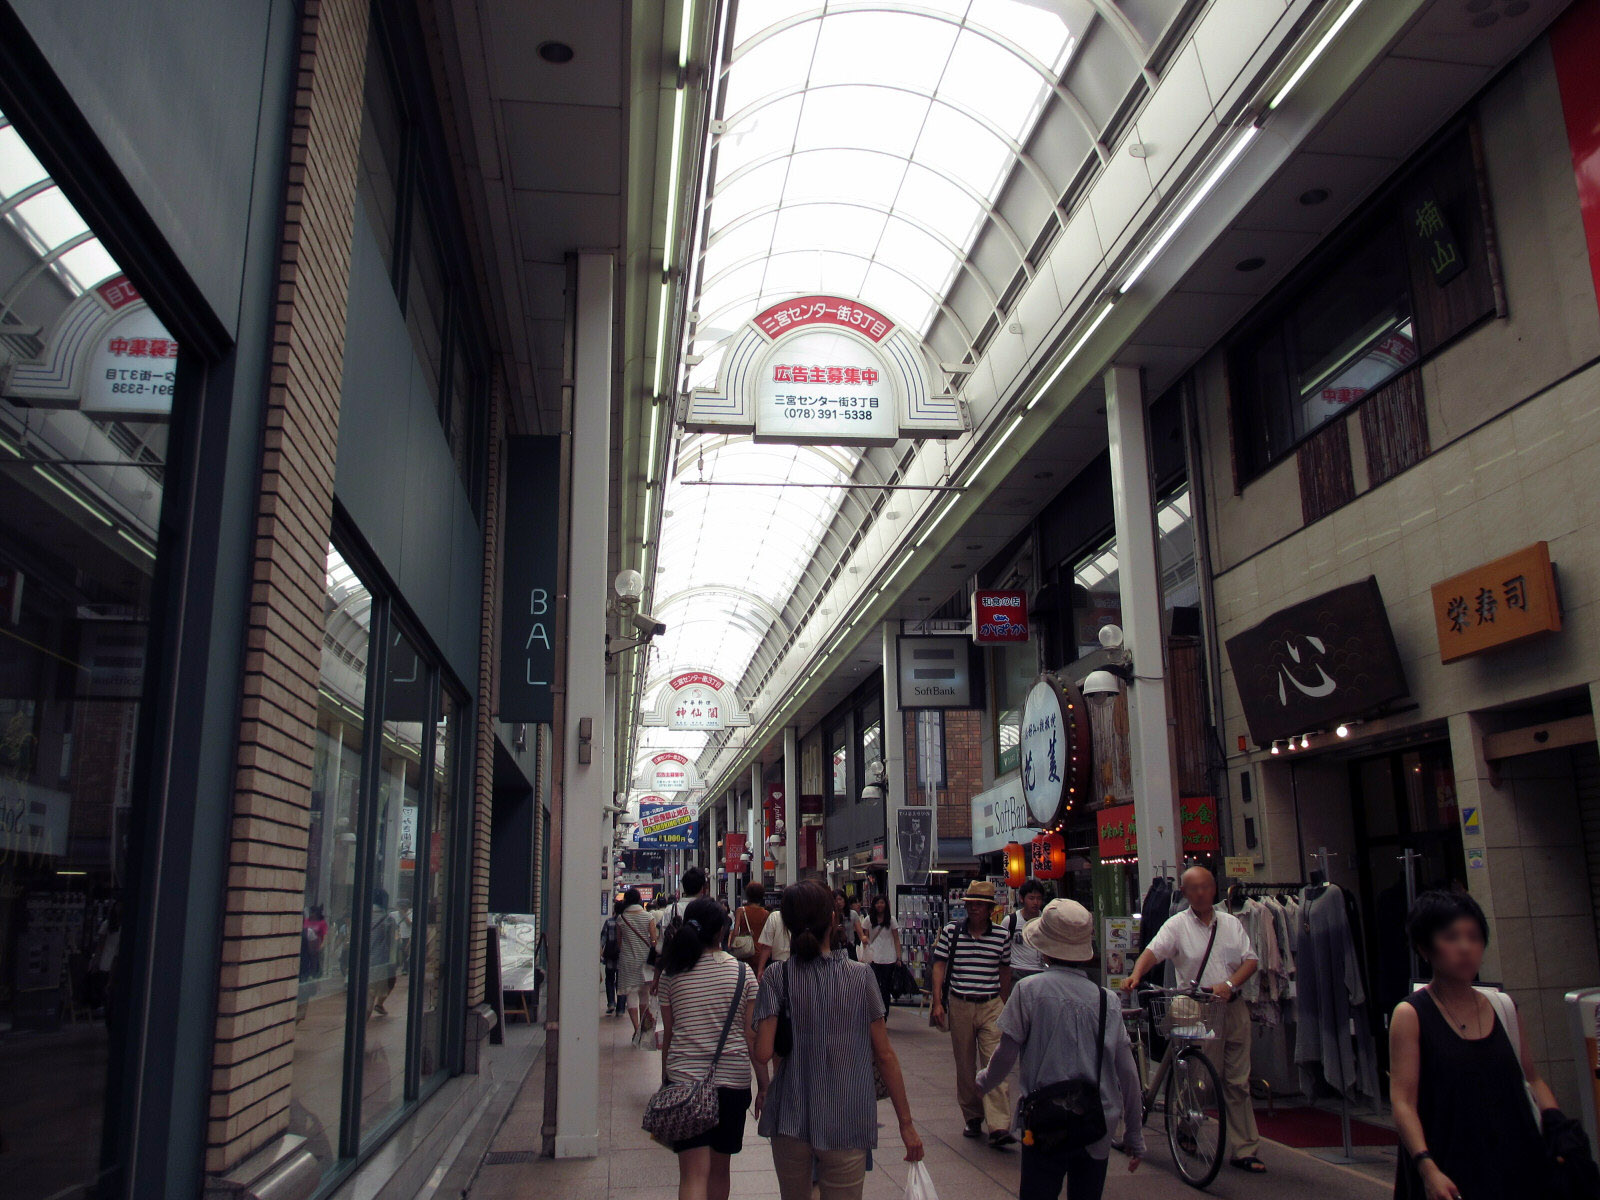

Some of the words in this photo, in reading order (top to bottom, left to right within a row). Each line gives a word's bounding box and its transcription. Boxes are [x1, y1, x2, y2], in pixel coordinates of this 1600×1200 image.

[761, 302, 888, 338] 三宮センター街3丁目
[773, 363, 880, 385] 広告主募集中
[774, 395, 880, 409] 三宮センター街3丁目
[783, 407, 874, 421] (078)391-5338
[981, 596, 1021, 608] 和食の店
[1447, 574, 1528, 634] 栄寿司
[525, 588, 551, 686] BAL
[1277, 635, 1338, 708] 心
[914, 686, 956, 697] SoftBank
[994, 795, 1027, 836] SoftBan
